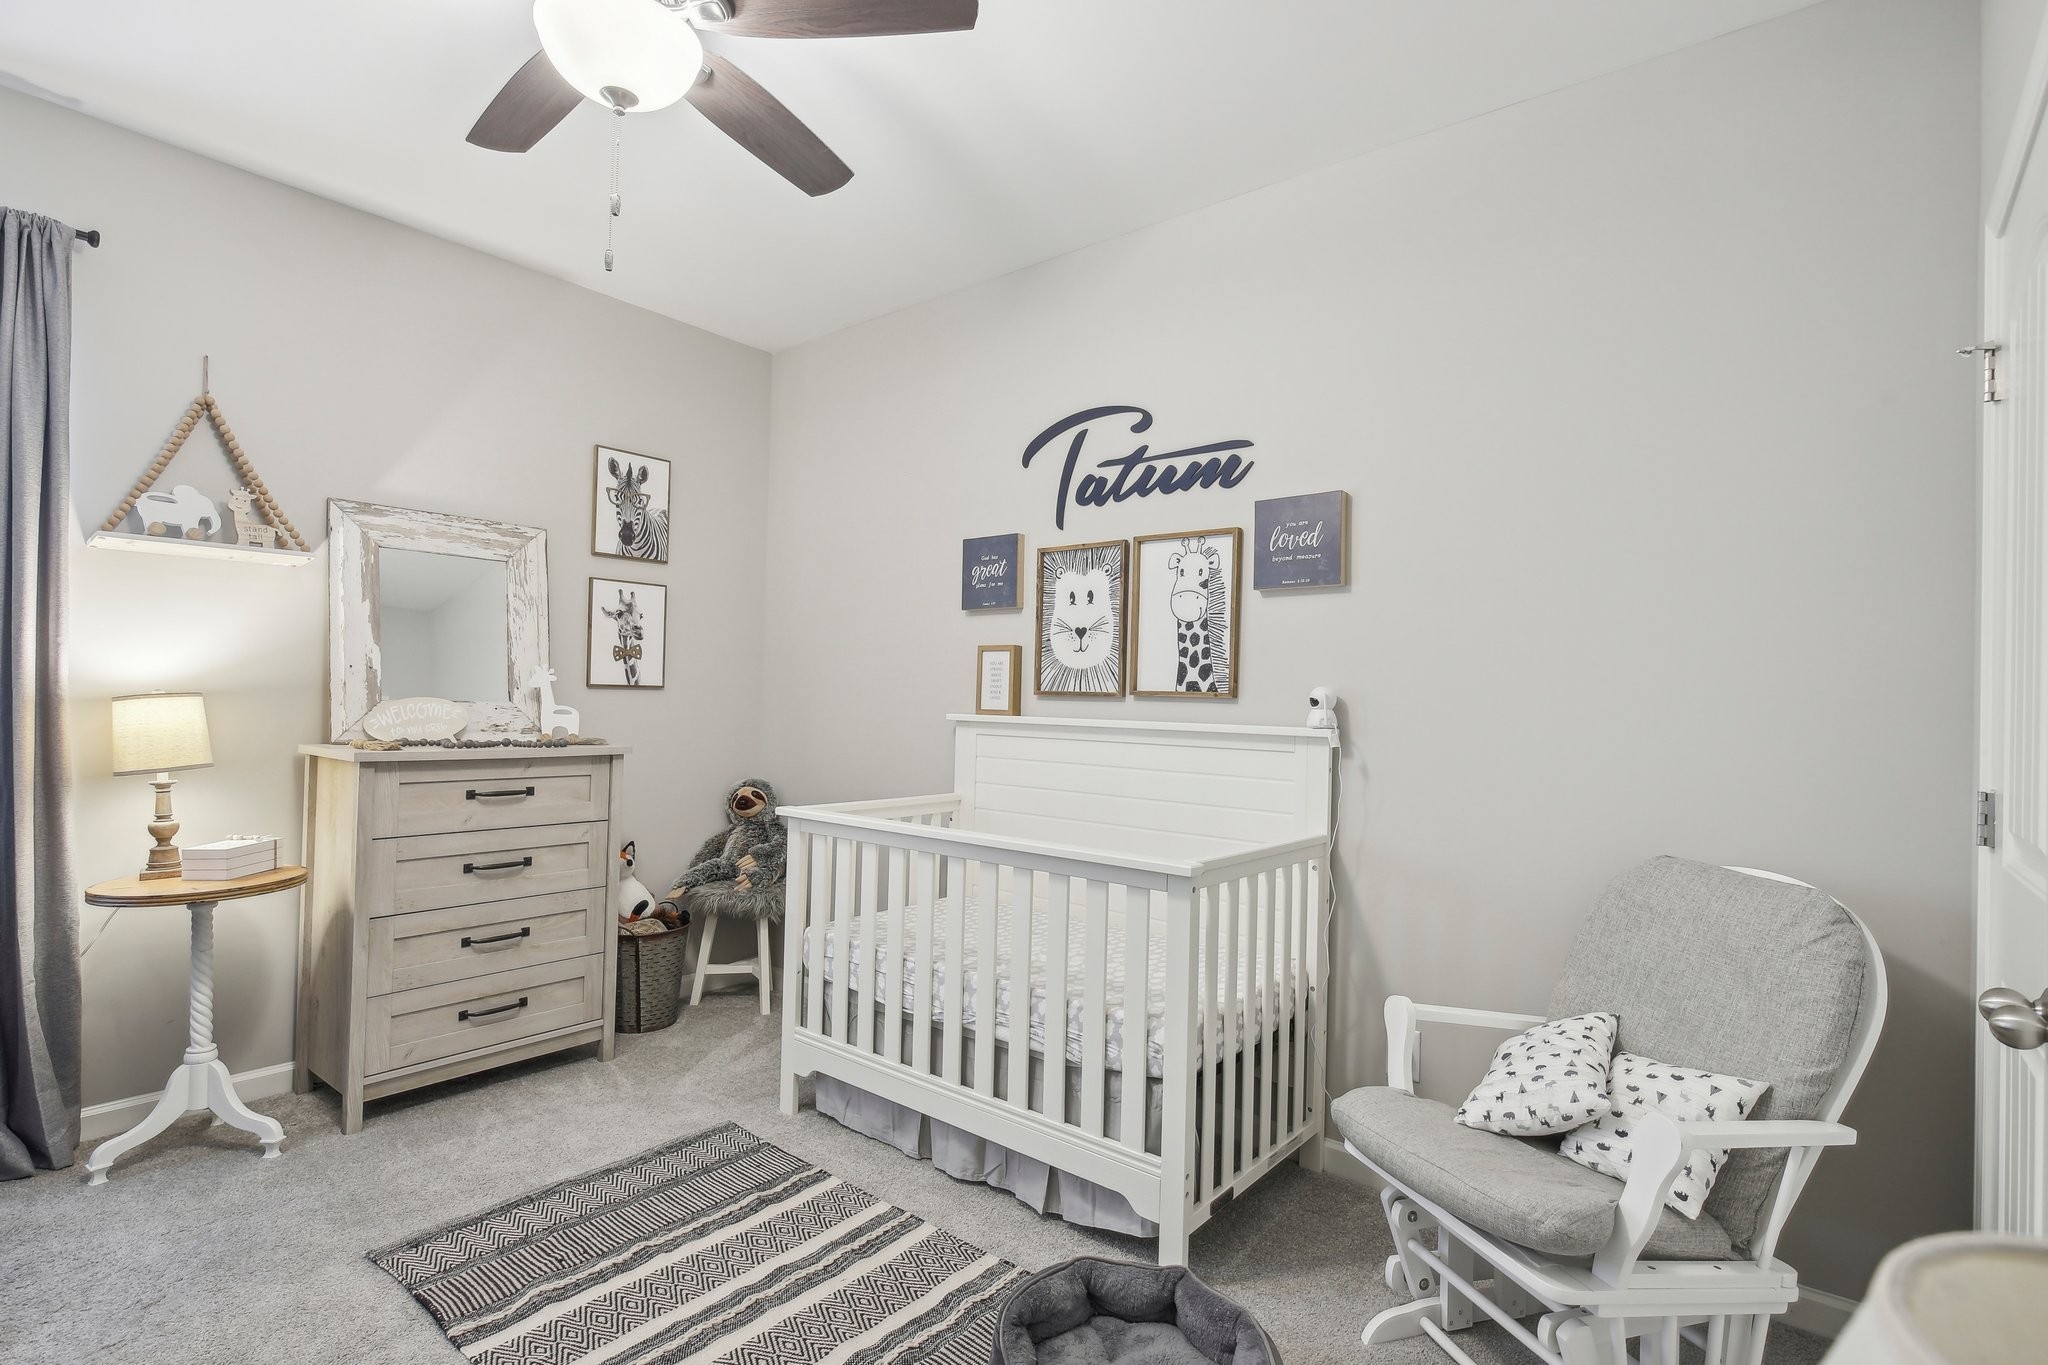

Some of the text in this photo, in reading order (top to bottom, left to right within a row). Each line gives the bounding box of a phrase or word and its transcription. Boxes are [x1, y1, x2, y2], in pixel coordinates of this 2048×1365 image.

[1022, 405, 1254, 531] Tatum
[243, 526, 268, 534] stand
[1269, 520, 1325, 552] loved
[971, 558, 1008, 586] great
[1271, 554, 1293, 563] beyond
